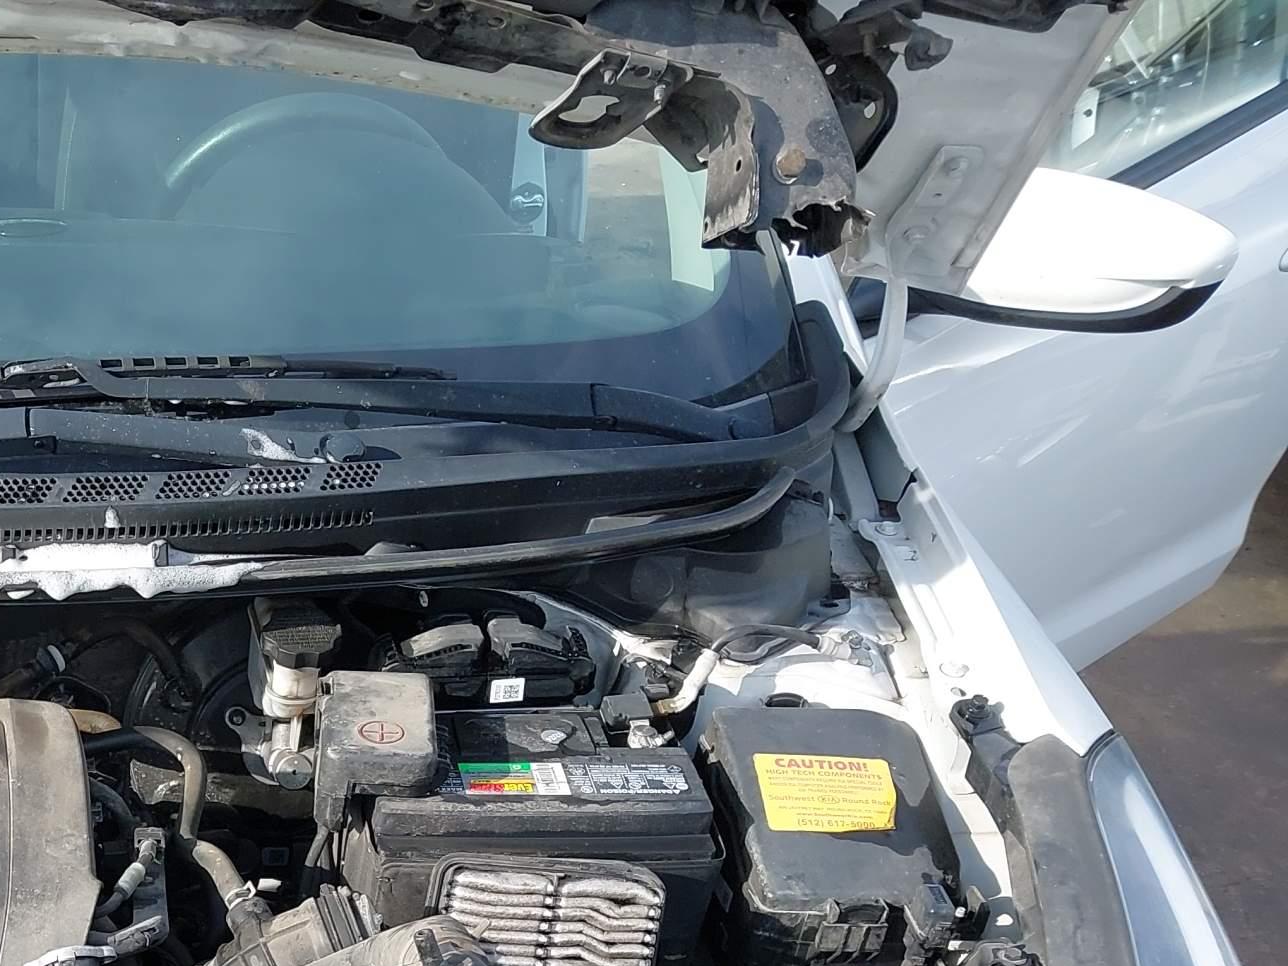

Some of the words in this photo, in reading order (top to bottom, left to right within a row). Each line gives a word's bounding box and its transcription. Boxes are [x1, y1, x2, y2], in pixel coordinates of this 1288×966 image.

[774, 758, 868, 772] CAUTION!
[792, 769, 815, 777] TECH
[817, 770, 883, 780] COMPONENTS
[768, 794, 816, 802] Southwest
[842, 796, 869, 804] Round
[797, 818, 824, 829] (512)
[827, 819, 876, 829] 617-5000
